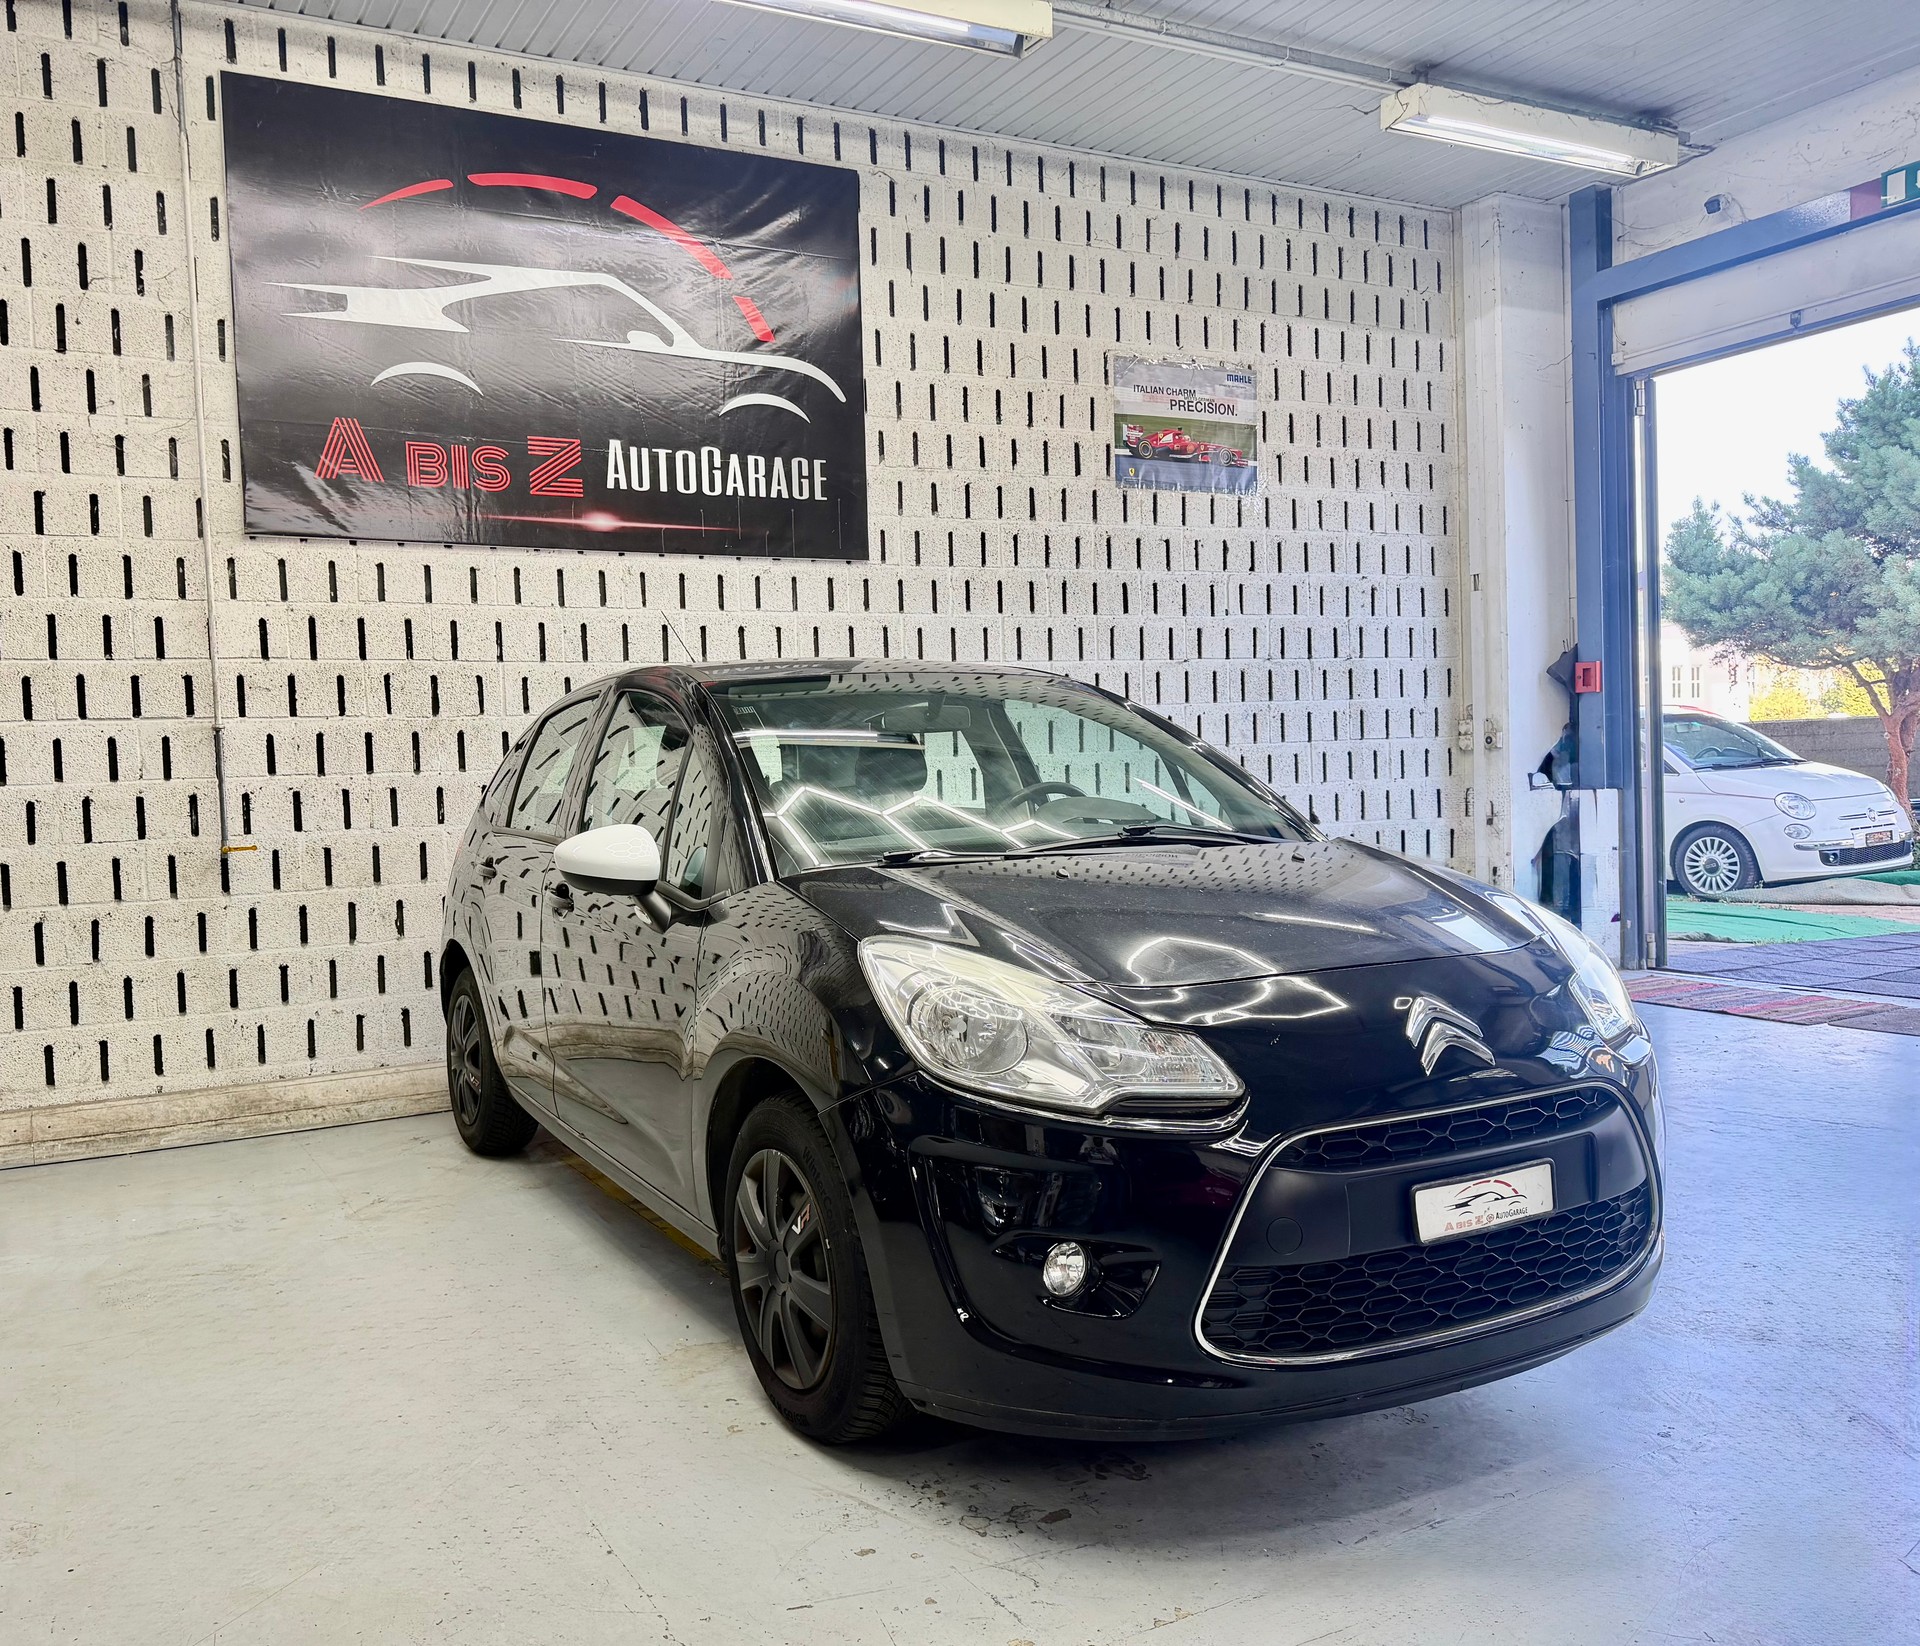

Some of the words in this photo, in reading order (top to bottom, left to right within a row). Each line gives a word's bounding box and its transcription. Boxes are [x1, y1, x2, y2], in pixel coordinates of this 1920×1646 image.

[1226, 374, 1252, 384] MAHLE
[1133, 385, 1164, 395] ITALIAN
[1166, 387, 1196, 398] CHARM
[1169, 399, 1238, 416] PRECISION.
[314, 417, 385, 483] A
[527, 435, 584, 498] Z
[1443, 1222, 1454, 1232] A
[1474, 1214, 1484, 1225] Z
